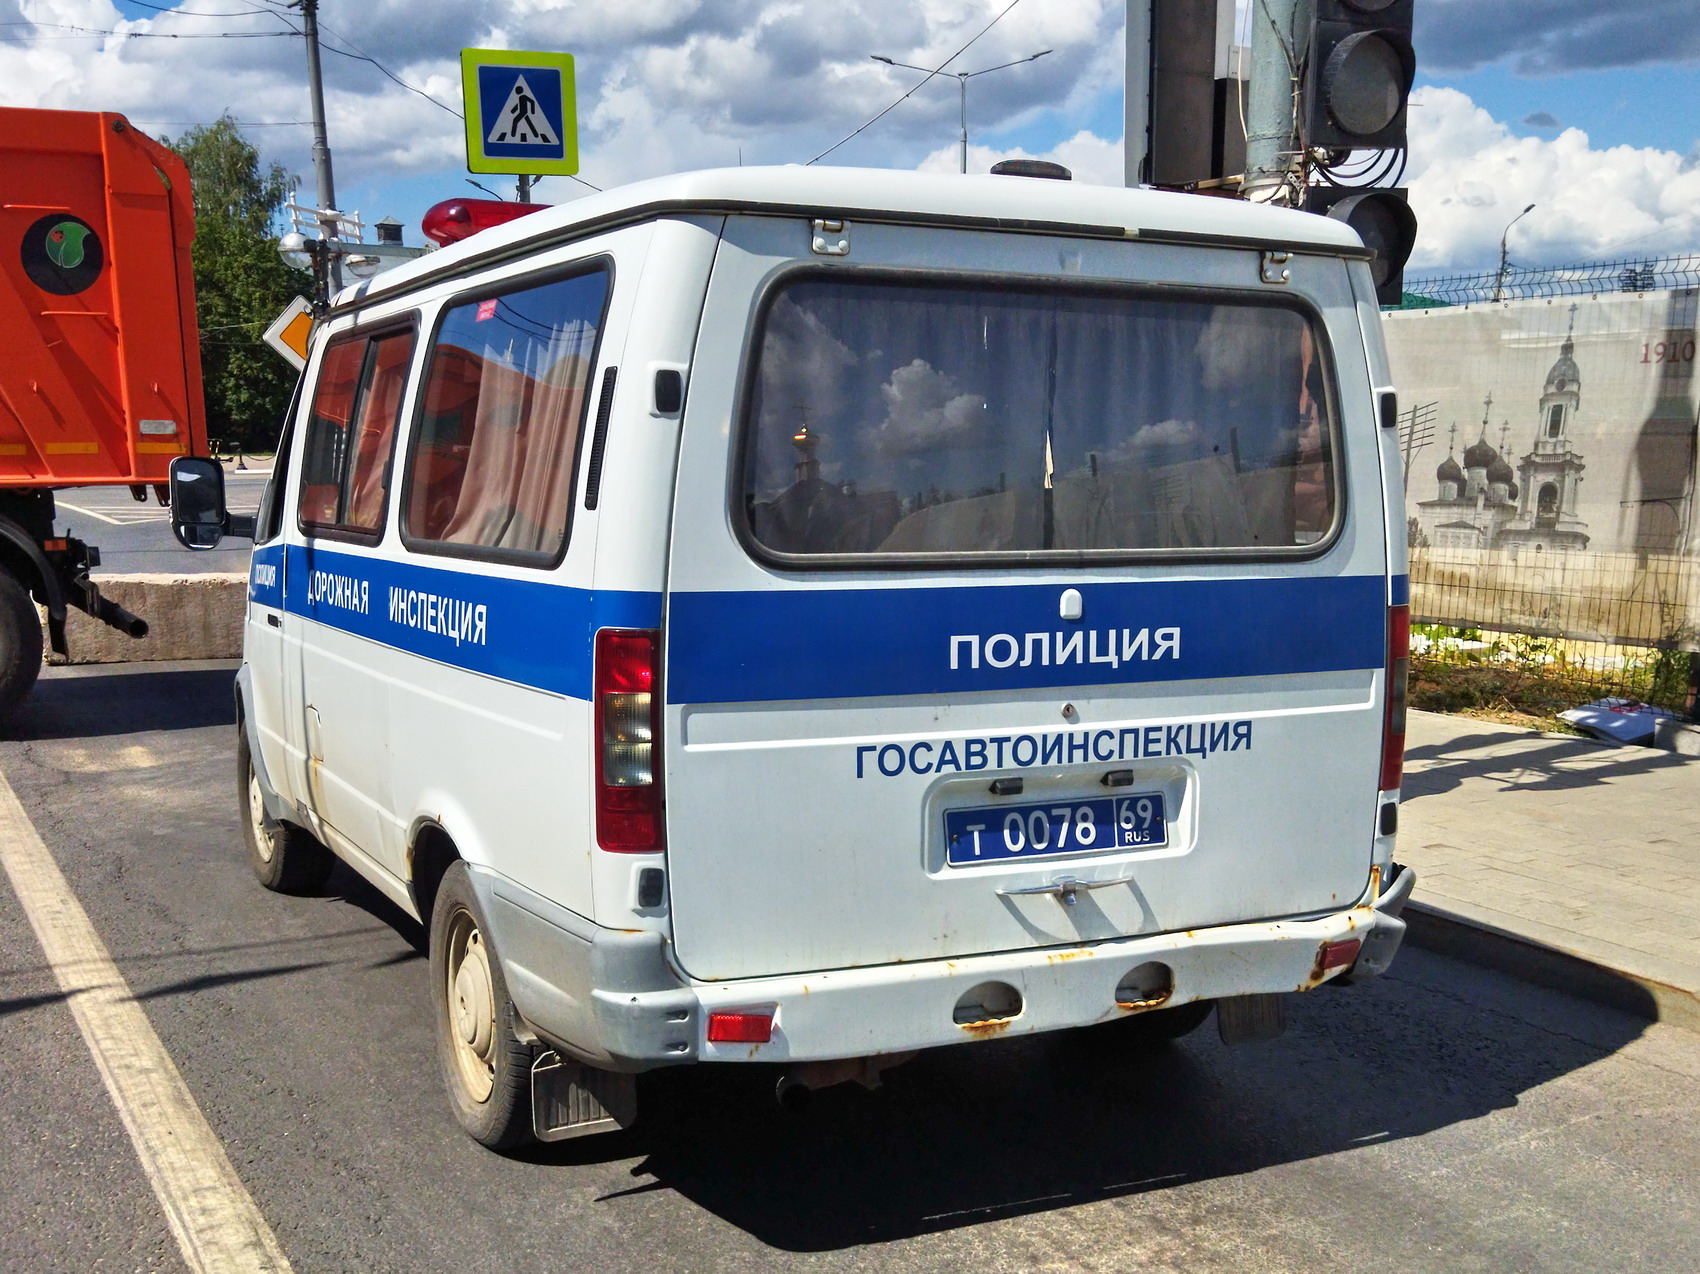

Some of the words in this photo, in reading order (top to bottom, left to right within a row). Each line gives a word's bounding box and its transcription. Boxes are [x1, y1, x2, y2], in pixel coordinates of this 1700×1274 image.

[1639, 340, 1696, 364] 1910
[307, 570, 369, 615] ДОРОЖНАЯ
[389, 586, 487, 647] ИНСПЕКЦИЯ
[949, 627, 1181, 670] ПОЛИЦИЯ
[856, 720, 1252, 779] ГОСАВТОИНСПЕКЦИЯ
[1003, 806, 1097, 853] 0078
[1119, 798, 1153, 831] 69
[1125, 830, 1151, 845] RUS
